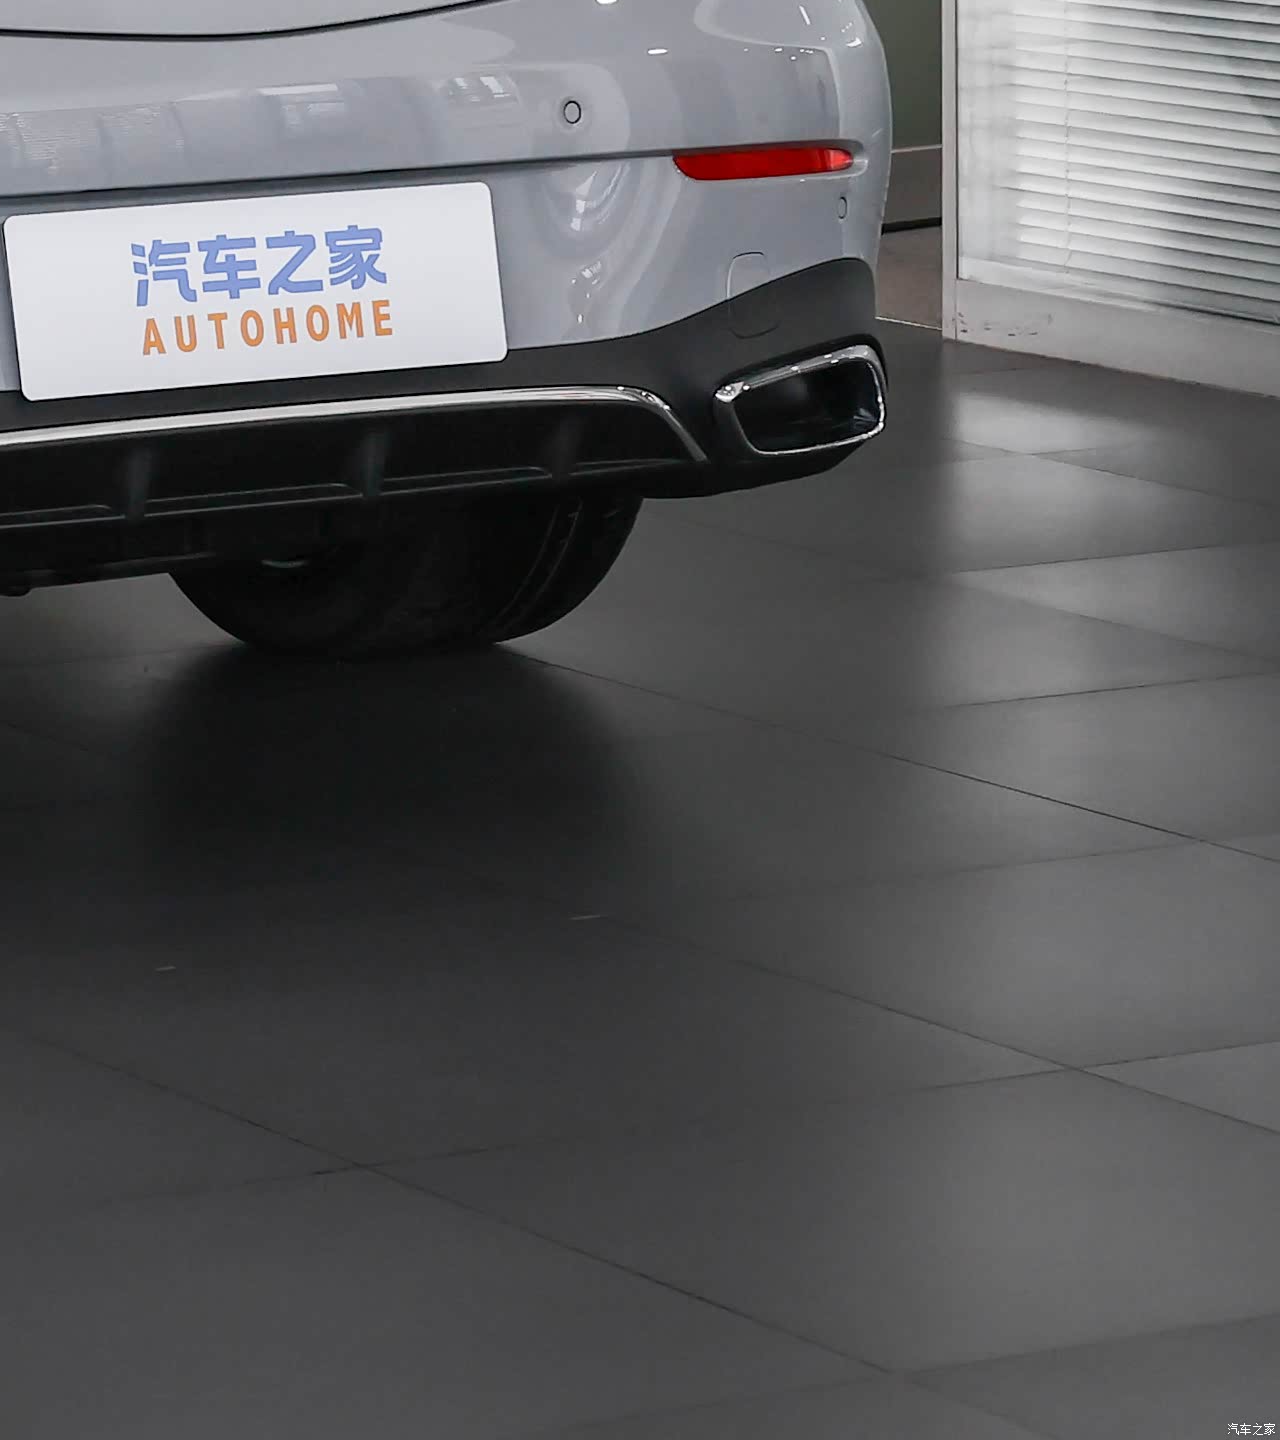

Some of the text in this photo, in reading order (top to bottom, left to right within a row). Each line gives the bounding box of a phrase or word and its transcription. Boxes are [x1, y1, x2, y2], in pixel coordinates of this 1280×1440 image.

[130, 225, 388, 307] 汽车之家
[142, 299, 394, 356] AUTOHOME
